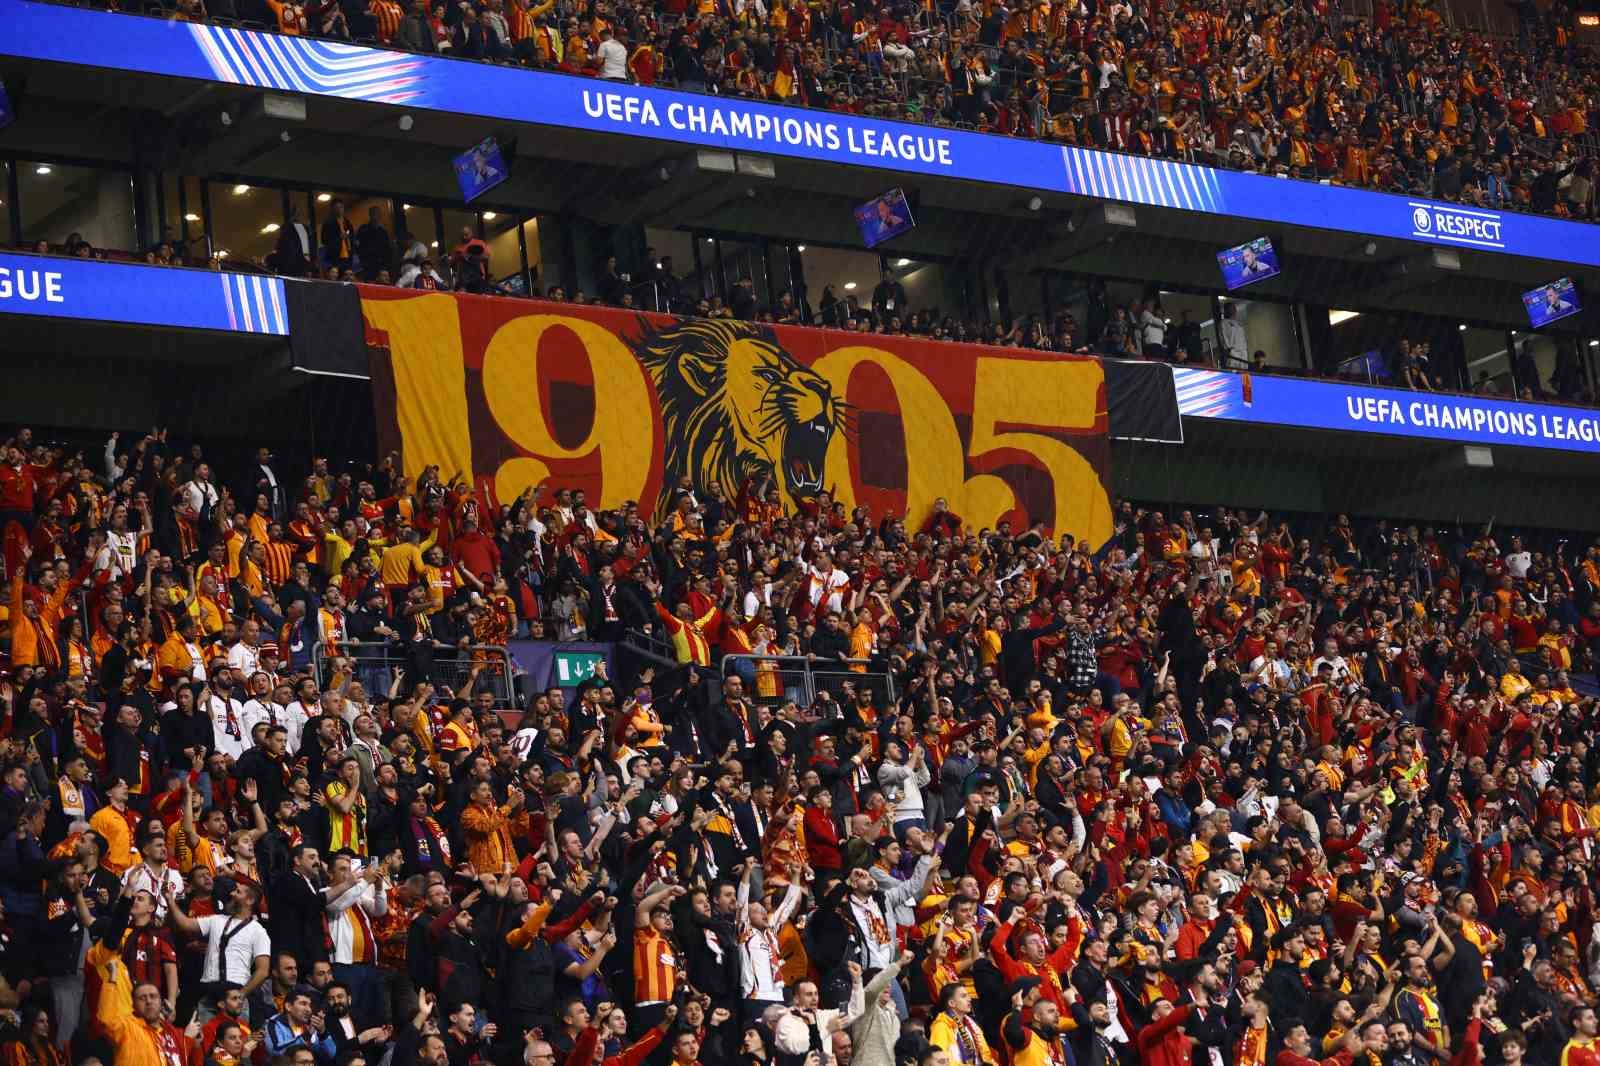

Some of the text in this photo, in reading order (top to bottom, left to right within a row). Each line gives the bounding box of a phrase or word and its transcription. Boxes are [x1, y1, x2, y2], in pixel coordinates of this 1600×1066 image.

[583, 90, 953, 165] UEFA CHAMPIONS LEAGUE
[1435, 213, 1501, 240] RESPECT
[1347, 397, 1405, 424] UEFA
[1409, 402, 1537, 437] CHAMPIONS
